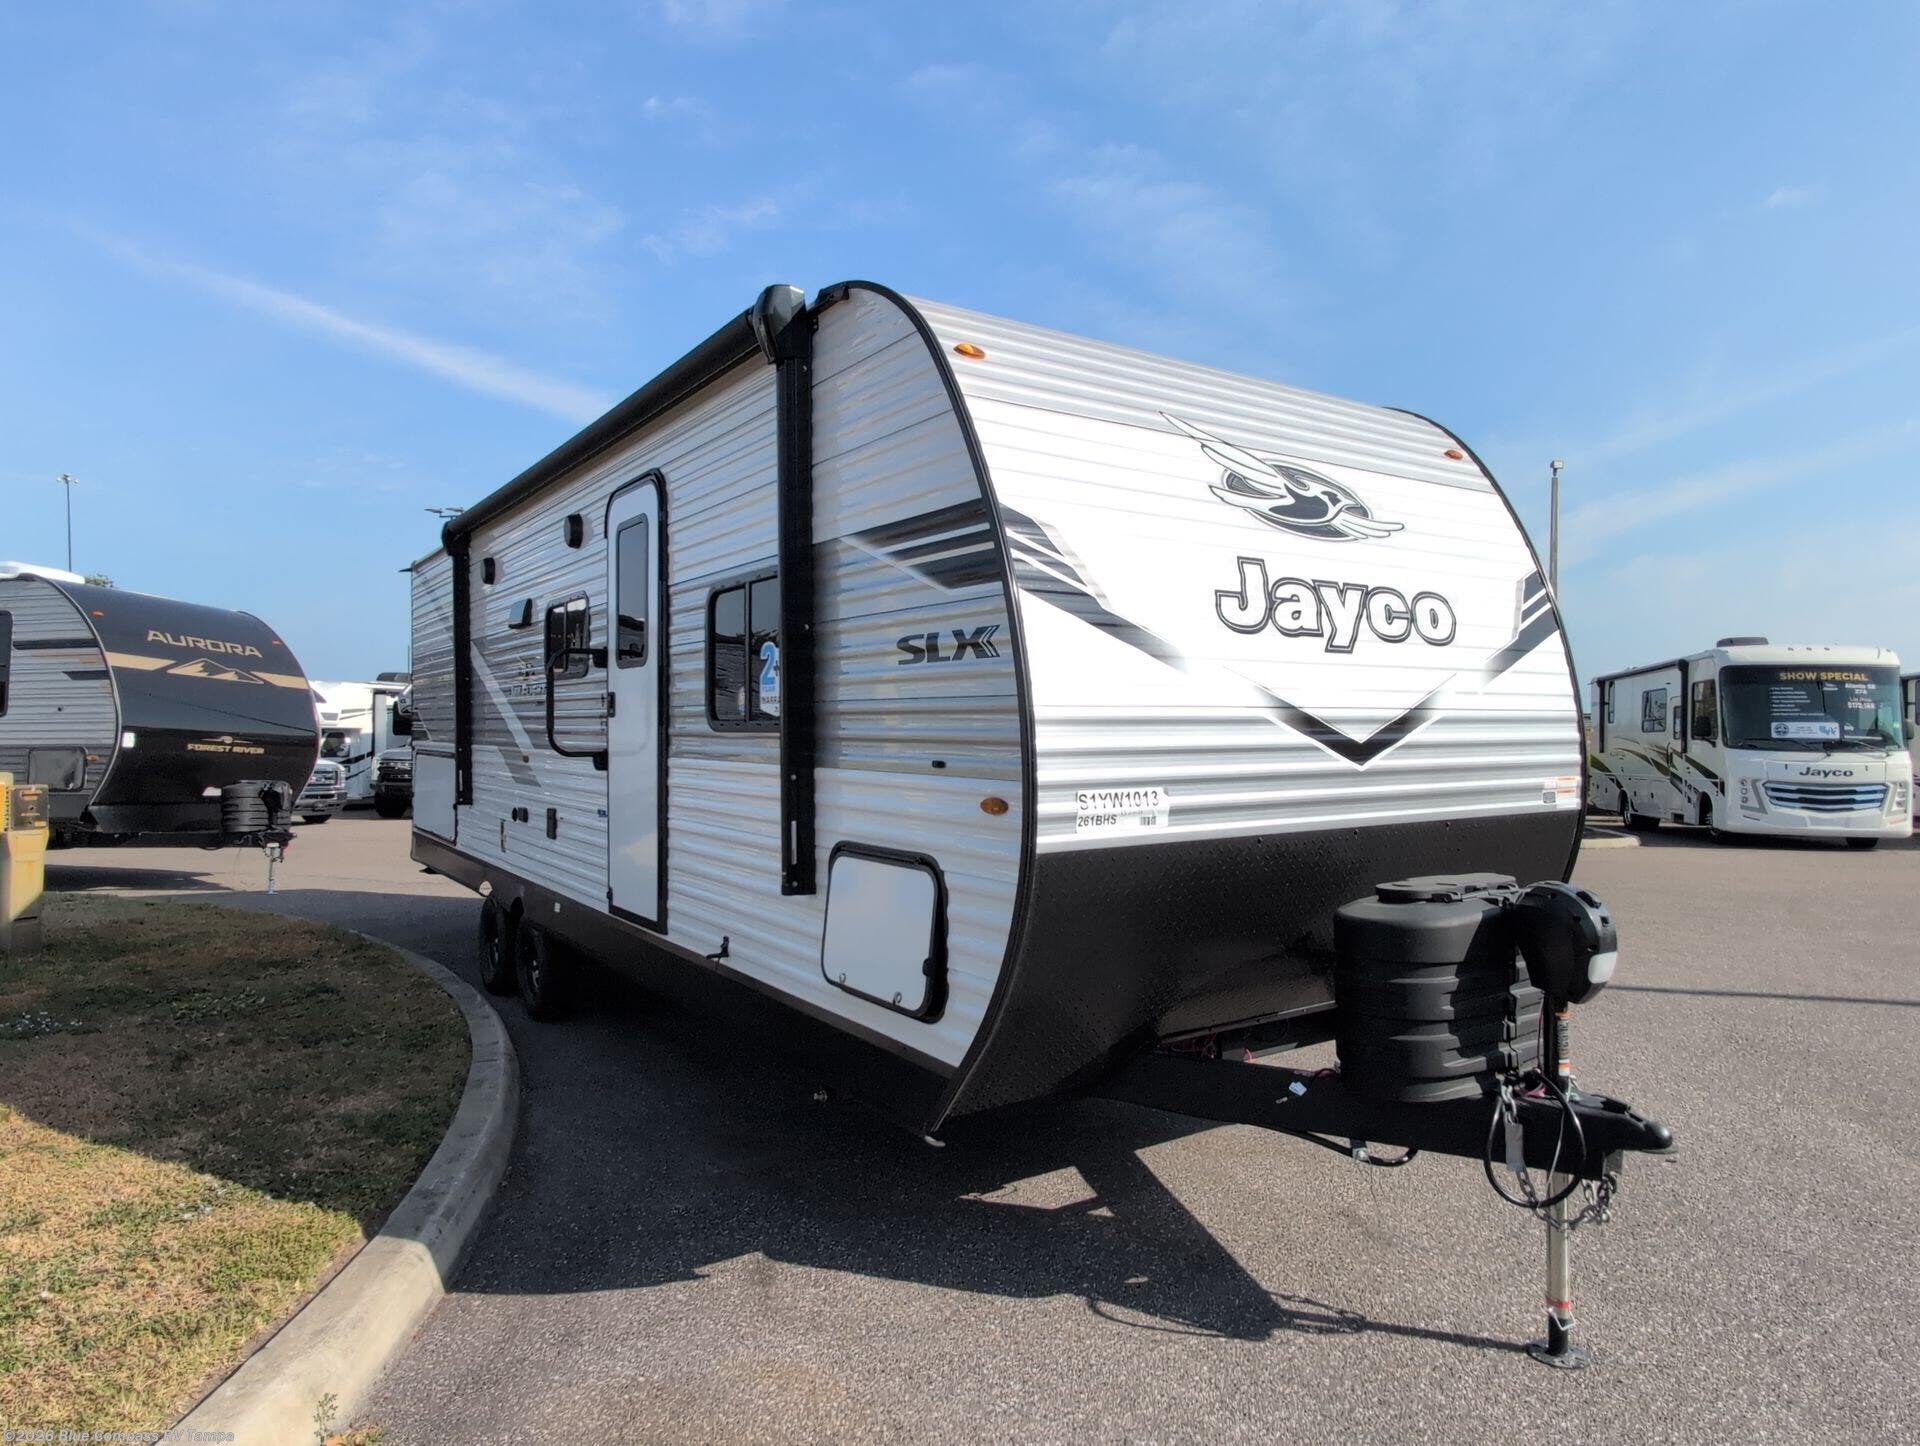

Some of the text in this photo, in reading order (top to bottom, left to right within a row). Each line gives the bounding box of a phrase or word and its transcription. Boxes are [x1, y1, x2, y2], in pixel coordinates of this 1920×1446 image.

[1214, 555, 1457, 655] Jayco
[147, 630, 263, 658] AURORA
[896, 624, 1001, 666] SLX
[1780, 672, 1869, 681] SHOW SPECIAL
[187, 743, 265, 755] FOREST RIVER
[1799, 767, 1854, 778] Jayco
[1078, 790, 1159, 811] S1YW1013
[1078, 814, 1117, 828] 261BHS
